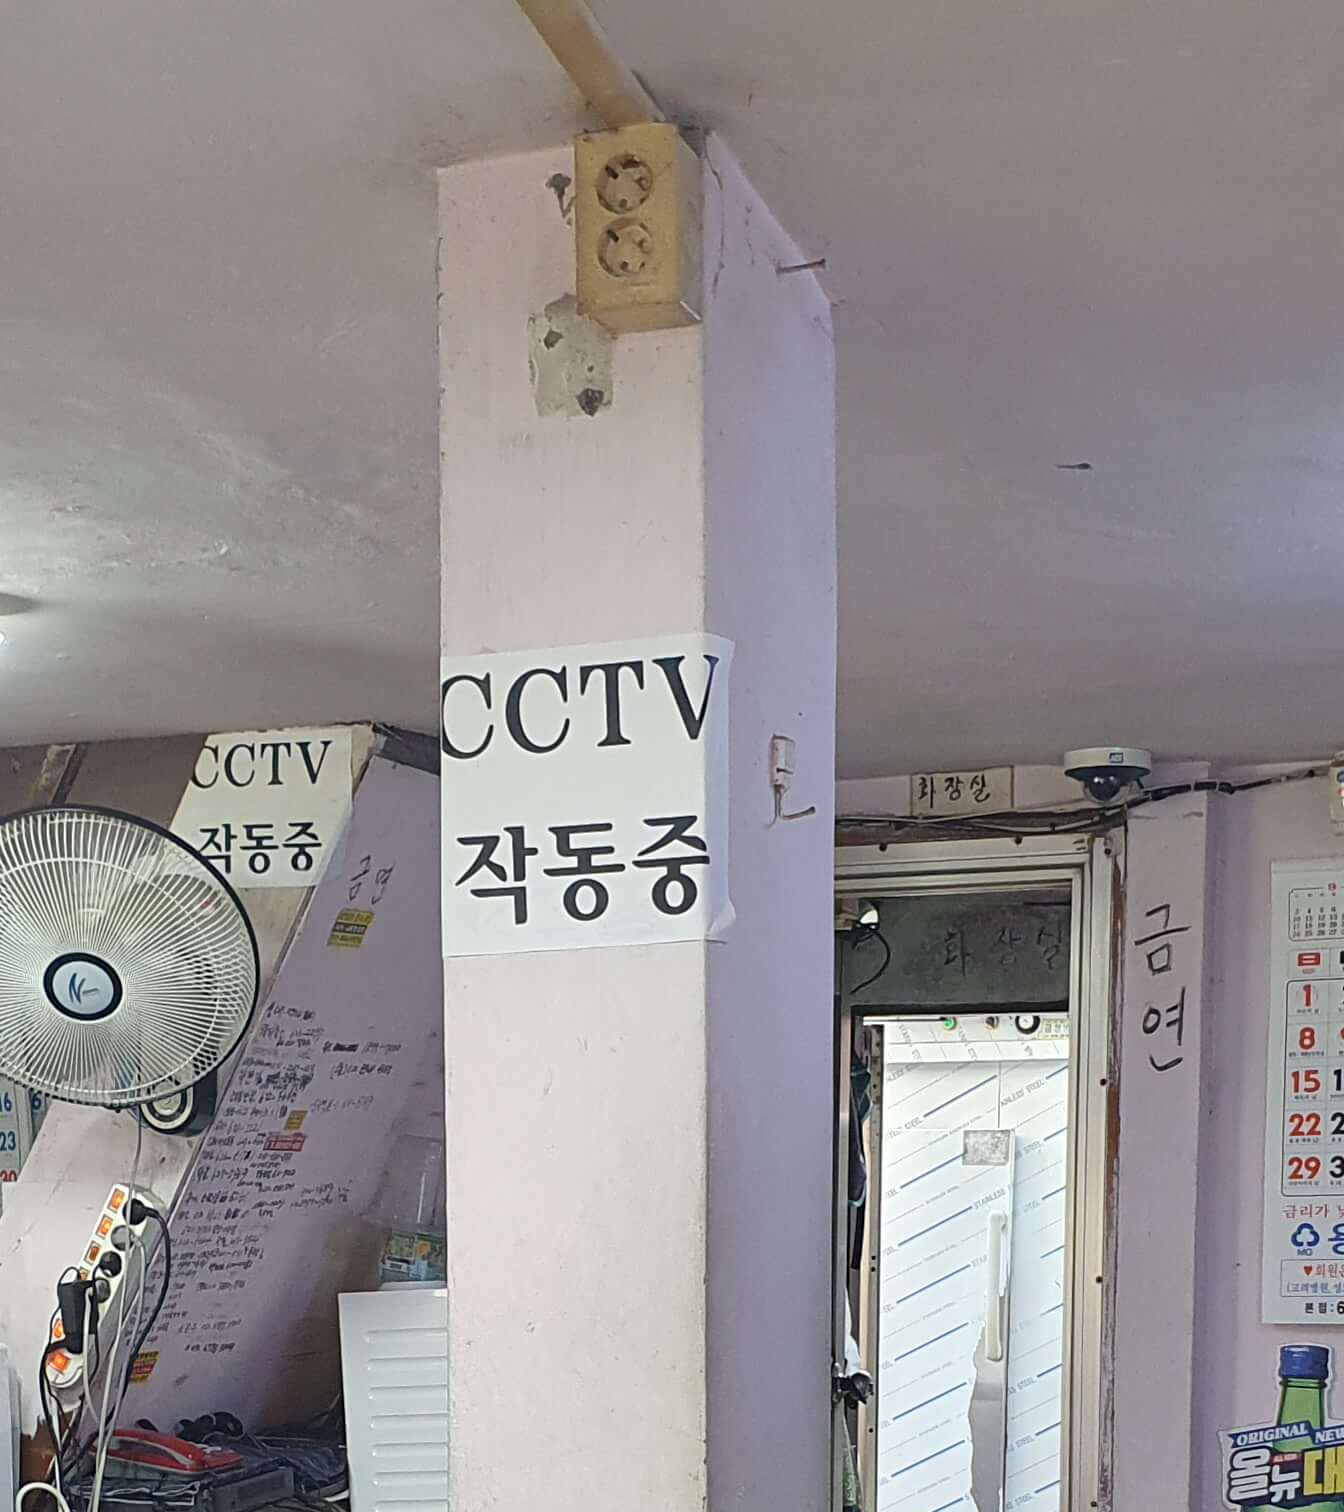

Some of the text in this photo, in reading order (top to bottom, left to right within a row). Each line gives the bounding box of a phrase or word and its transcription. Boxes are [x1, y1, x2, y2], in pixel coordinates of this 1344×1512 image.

[440, 653, 719, 759] CCTV
[191, 741, 333, 789] CCTV
[918, 774, 991, 808] 화장실
[199, 822, 322, 874] 작동중
[454, 814, 710, 925] 작동중
[1297, 952, 1321, 966] 日
[1302, 984, 1313, 1008] 1
[1299, 1027, 1316, 1050] 8
[1291, 1069, 1321, 1093] 15
[1288, 1113, 1321, 1137] 22
[1288, 1155, 1321, 1179] 29
[1283, 1203, 1329, 1218] 금리가
[1236, 1422, 1310, 1446] ORIGINAL
